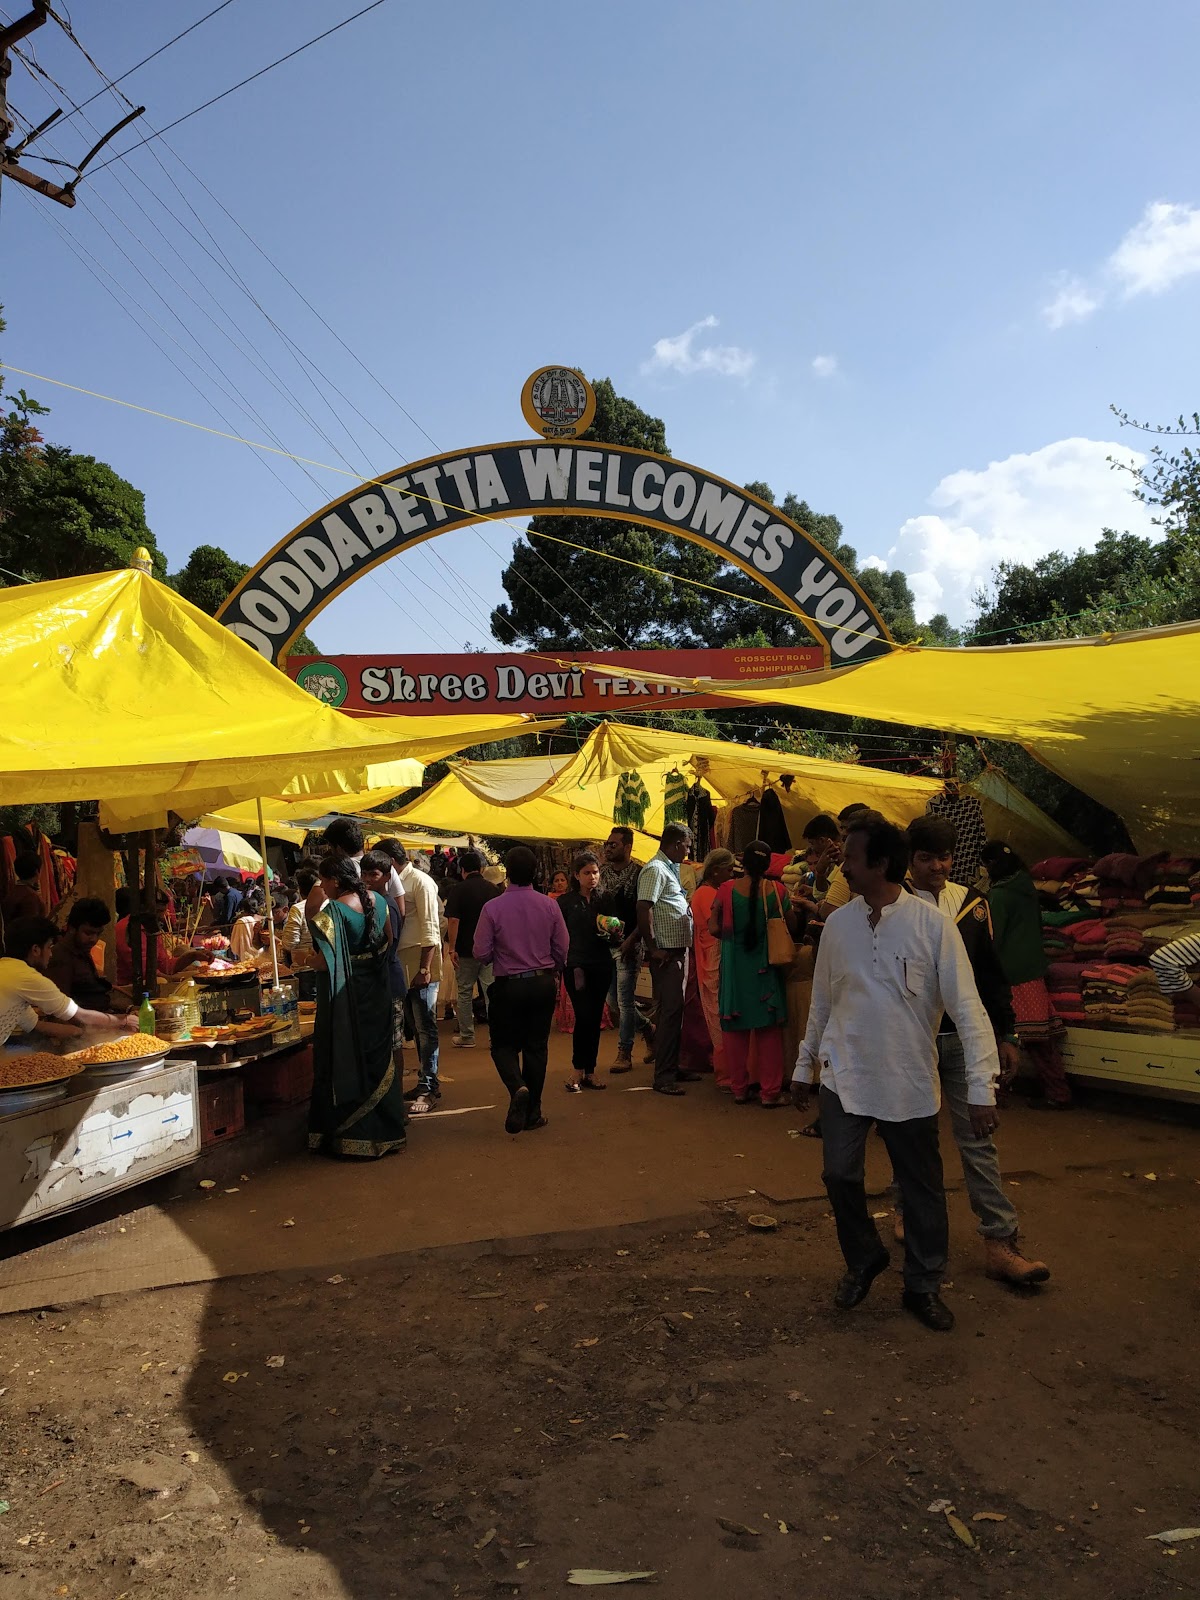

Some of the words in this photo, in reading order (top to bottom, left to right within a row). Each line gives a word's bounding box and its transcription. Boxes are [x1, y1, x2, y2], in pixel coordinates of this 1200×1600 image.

[519, 447, 794, 573] WELCOMES
[794, 556, 880, 658] YOU
[734, 655, 784, 663] CROSSCUT
[739, 665, 807, 673] GANDHIPURAM
[361, 666, 488, 702] Shree
[495, 665, 586, 701] Devi
